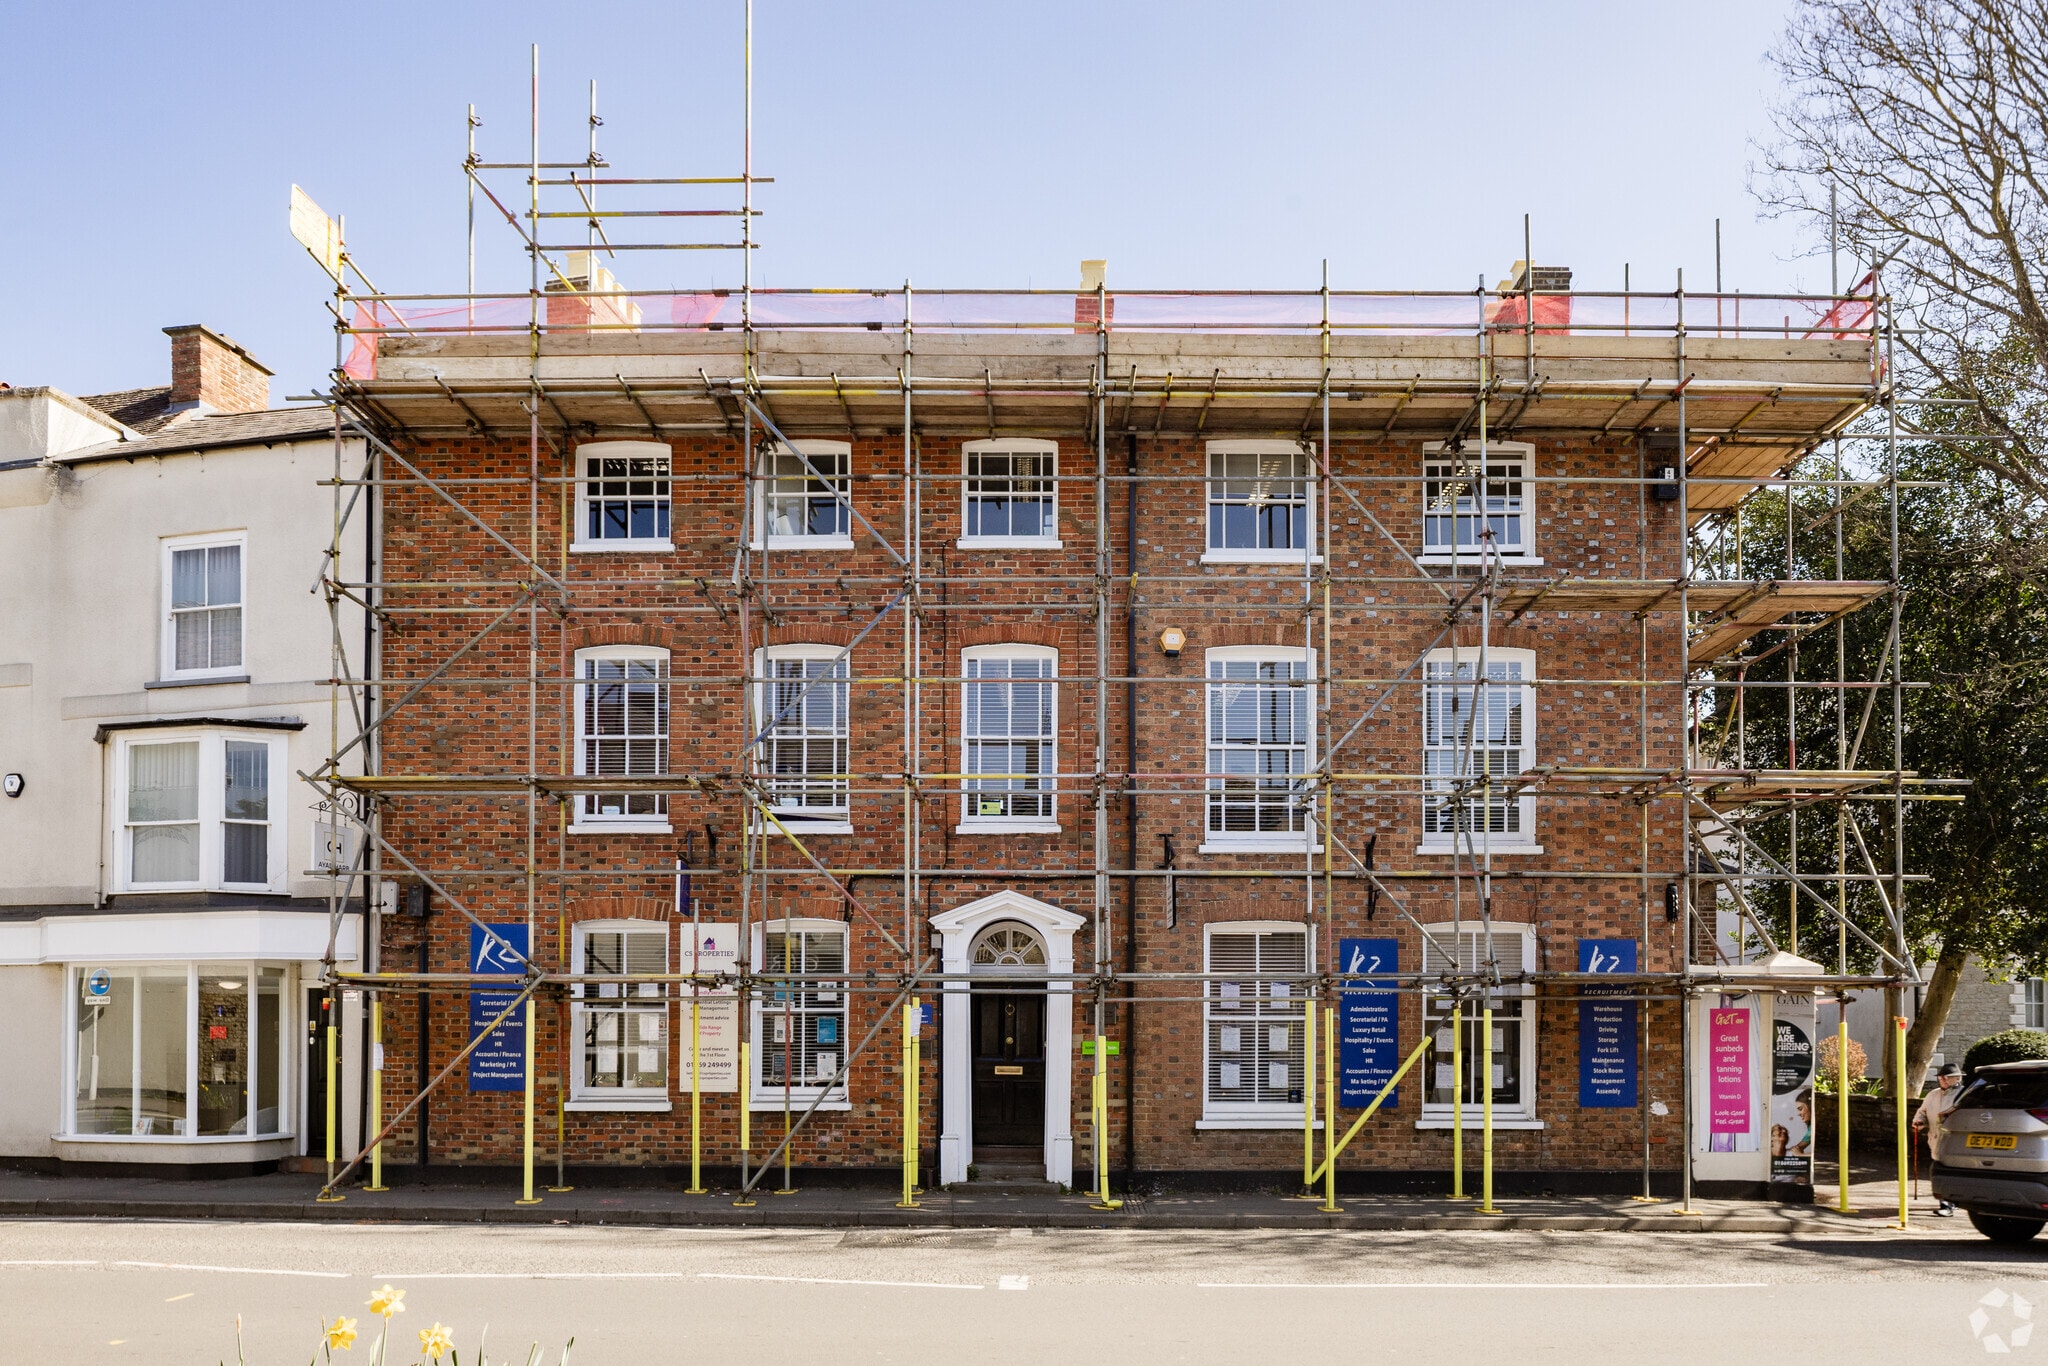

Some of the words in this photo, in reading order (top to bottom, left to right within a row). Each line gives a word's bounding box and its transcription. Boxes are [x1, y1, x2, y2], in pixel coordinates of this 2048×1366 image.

[1776, 995, 1810, 1005] GAIN
[482, 1010, 501, 1018] Luxury
[1598, 1026, 1618, 1034] Driving
[1776, 1026, 1791, 1034] WE
[1344, 1037, 1373, 1045] Hospitality
[1776, 1035, 1795, 1043] ARE
[1715, 1044, 1744, 1052] sunbeds
[1776, 1042, 1810, 1051] HIRING
[1716, 1065, 1743, 1074] tanning
[1718, 1075, 1741, 1083] lotions
[1595, 1088, 1621, 1096] Assembly
